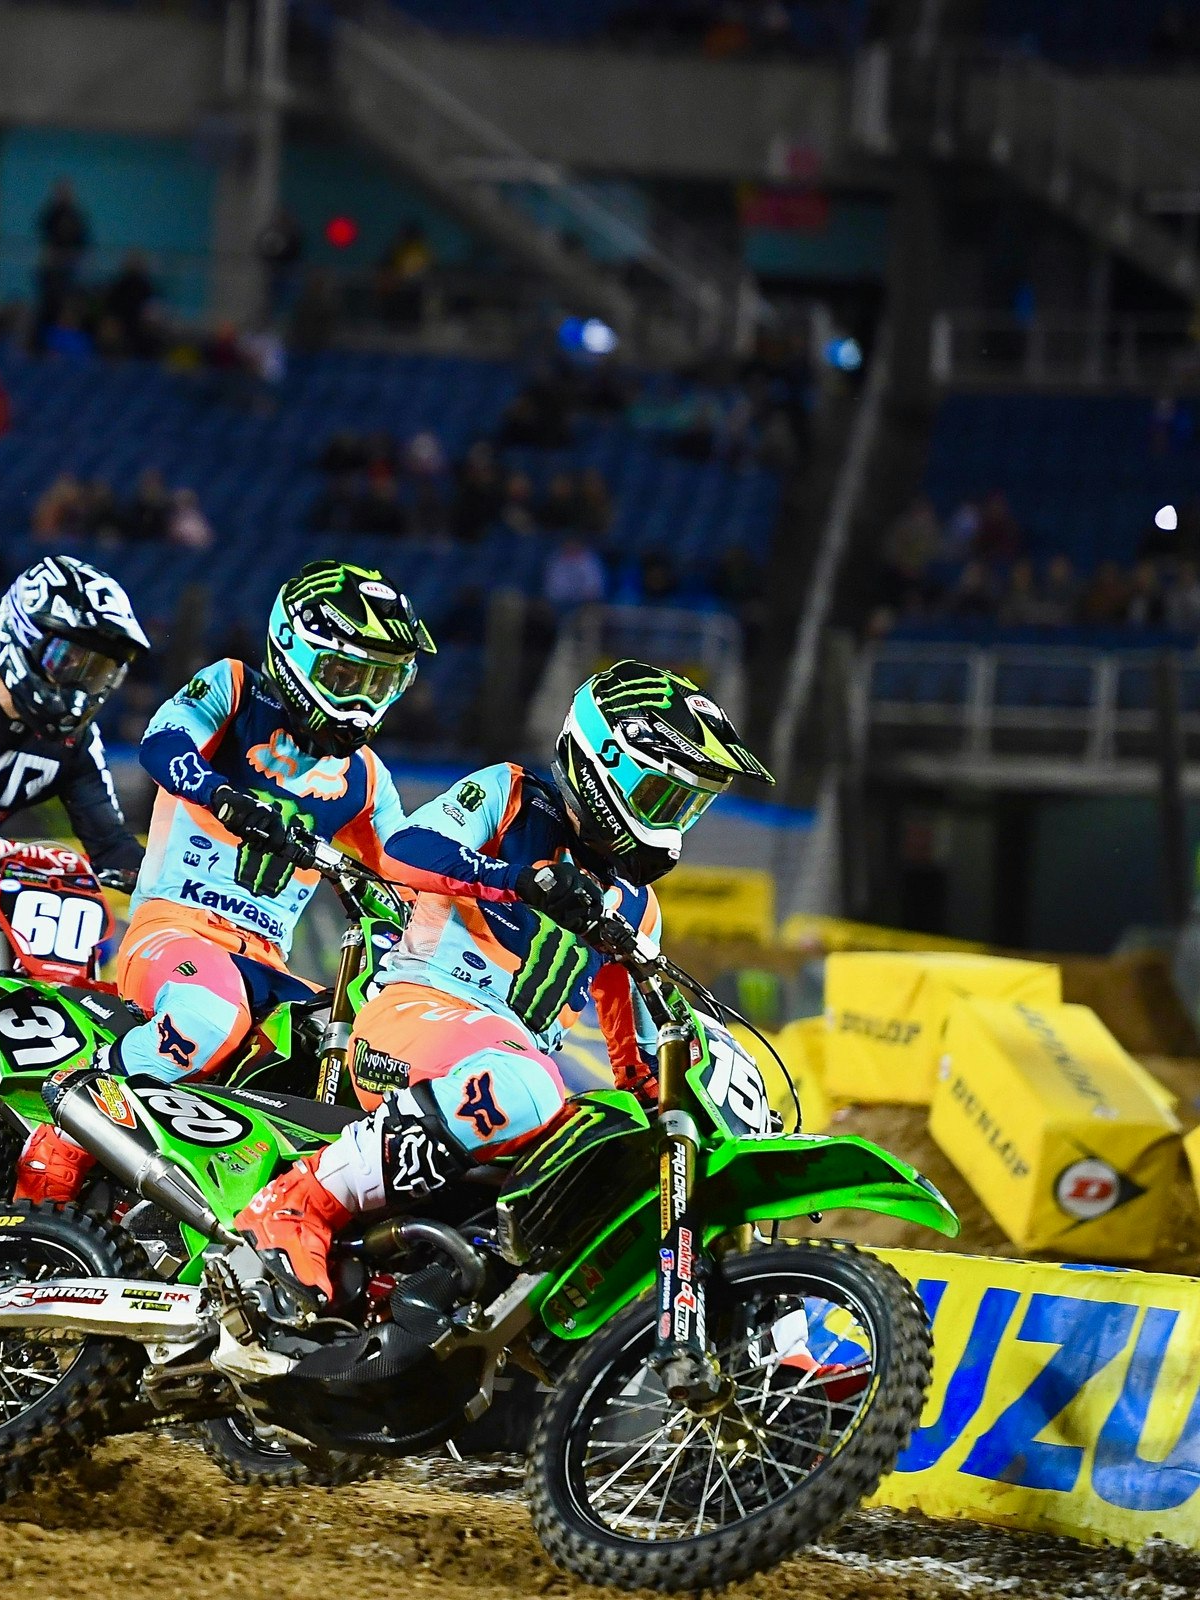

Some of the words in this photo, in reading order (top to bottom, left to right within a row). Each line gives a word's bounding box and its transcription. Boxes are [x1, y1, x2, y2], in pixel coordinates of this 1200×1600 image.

[274, 655, 311, 711] MONSTER
[579, 783, 608, 829] ENERGY
[580, 764, 621, 836] MONSTER
[11, 890, 105, 964] 60
[180, 877, 286, 938] Kawasa
[363, 1051, 410, 1077] MONSTER
[707, 1039, 768, 1132] 15
[133, 1086, 243, 1142] 150
[231, 1088, 288, 1109] Kawasaki
[951, 1075, 1030, 1179] DUNLOP
[671, 1141, 686, 1177] PRO
[677, 1227, 692, 1282] BRAKING
[164, 1292, 193, 1303] RK
